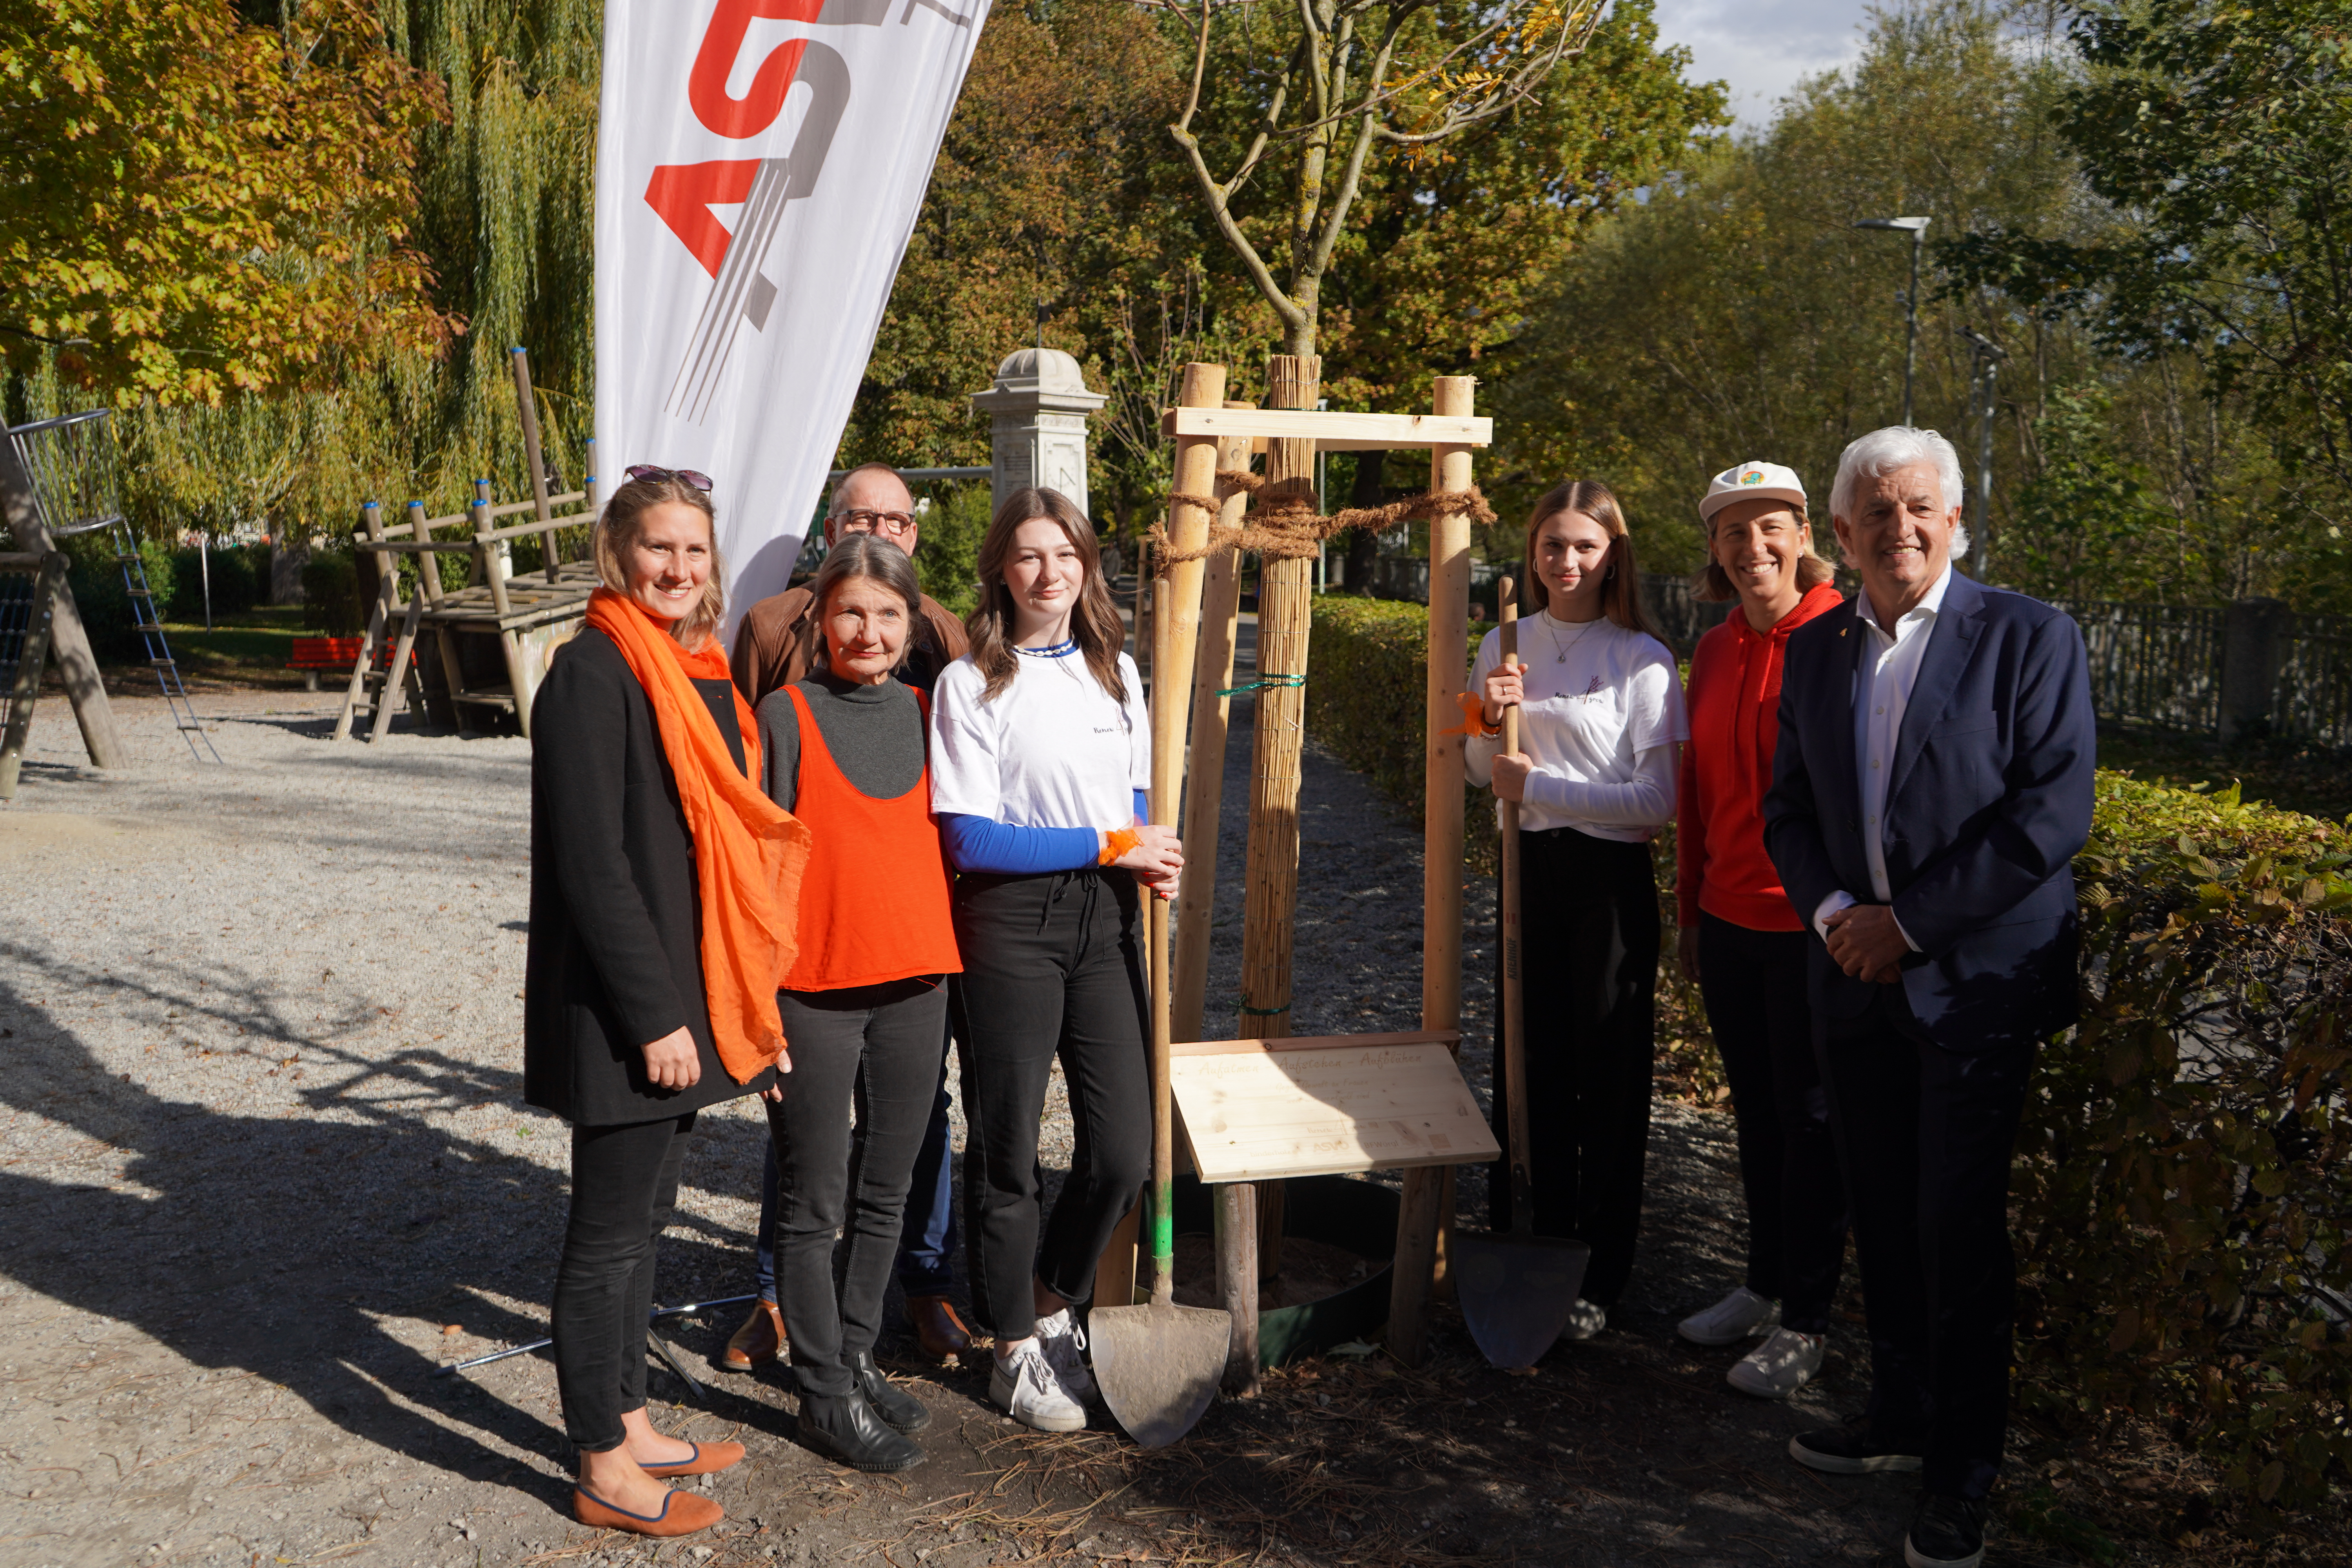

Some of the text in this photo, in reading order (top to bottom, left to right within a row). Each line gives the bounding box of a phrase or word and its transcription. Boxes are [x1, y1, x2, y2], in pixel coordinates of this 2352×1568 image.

[1506, 936, 1517, 980] KRENHOF
[1198, 1061, 1259, 1079] Aufatmen
[1278, 1056, 1341, 1074] Aufstehen
[1360, 1051, 1421, 1069] Aufblühen
